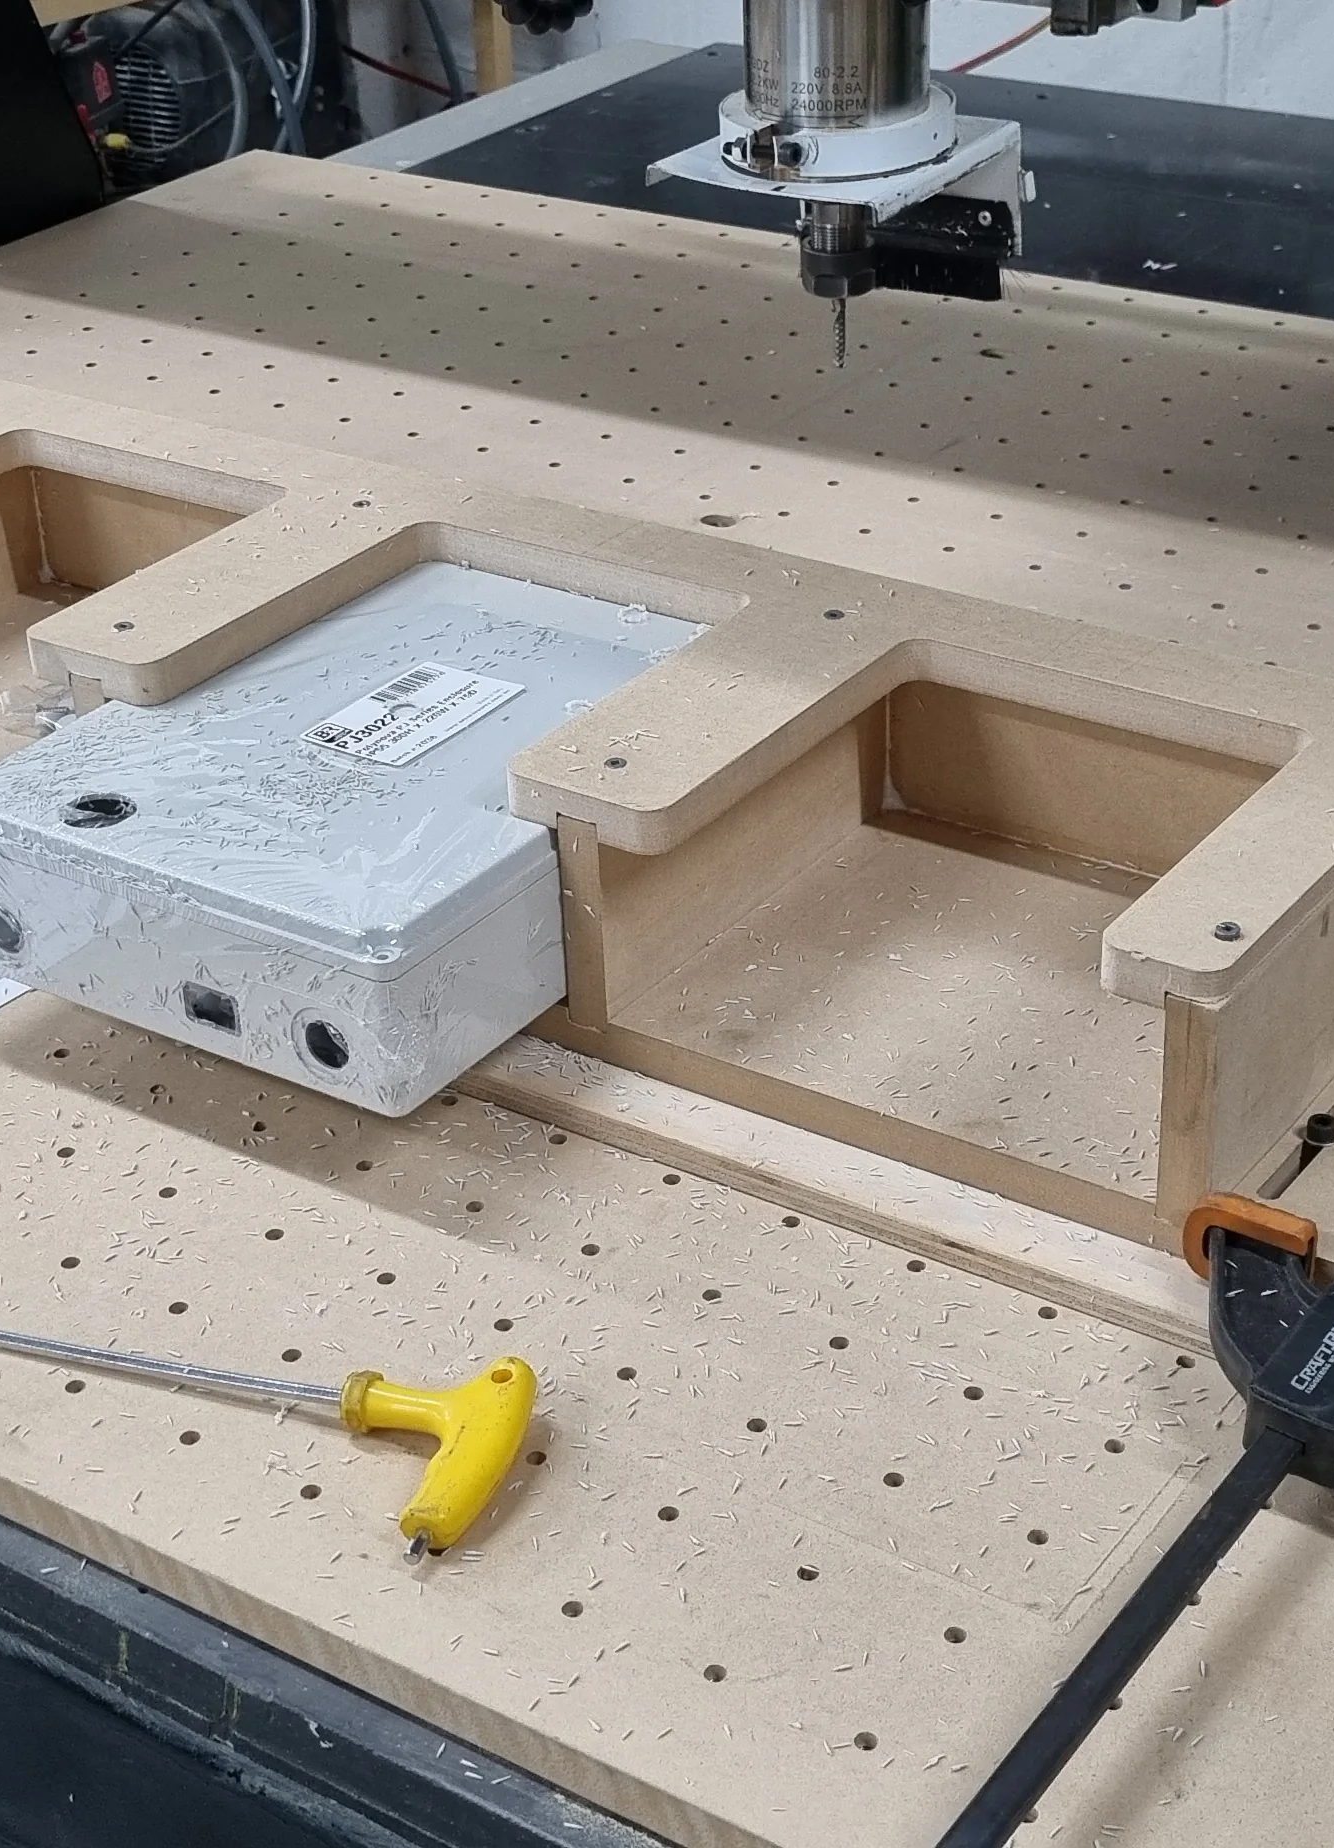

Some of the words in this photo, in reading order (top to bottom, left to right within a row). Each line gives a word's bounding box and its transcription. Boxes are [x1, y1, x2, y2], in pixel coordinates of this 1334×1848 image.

[813, 65, 859, 79] 80-2.2
[790, 82, 825, 95] 220V
[832, 81, 863, 95] 8.8A
[790, 98, 867, 112] 24000RPM
[408, 704, 439, 722] Series
[437, 679, 479, 706] Enclosure
[334, 712, 400, 750] PJ3022
